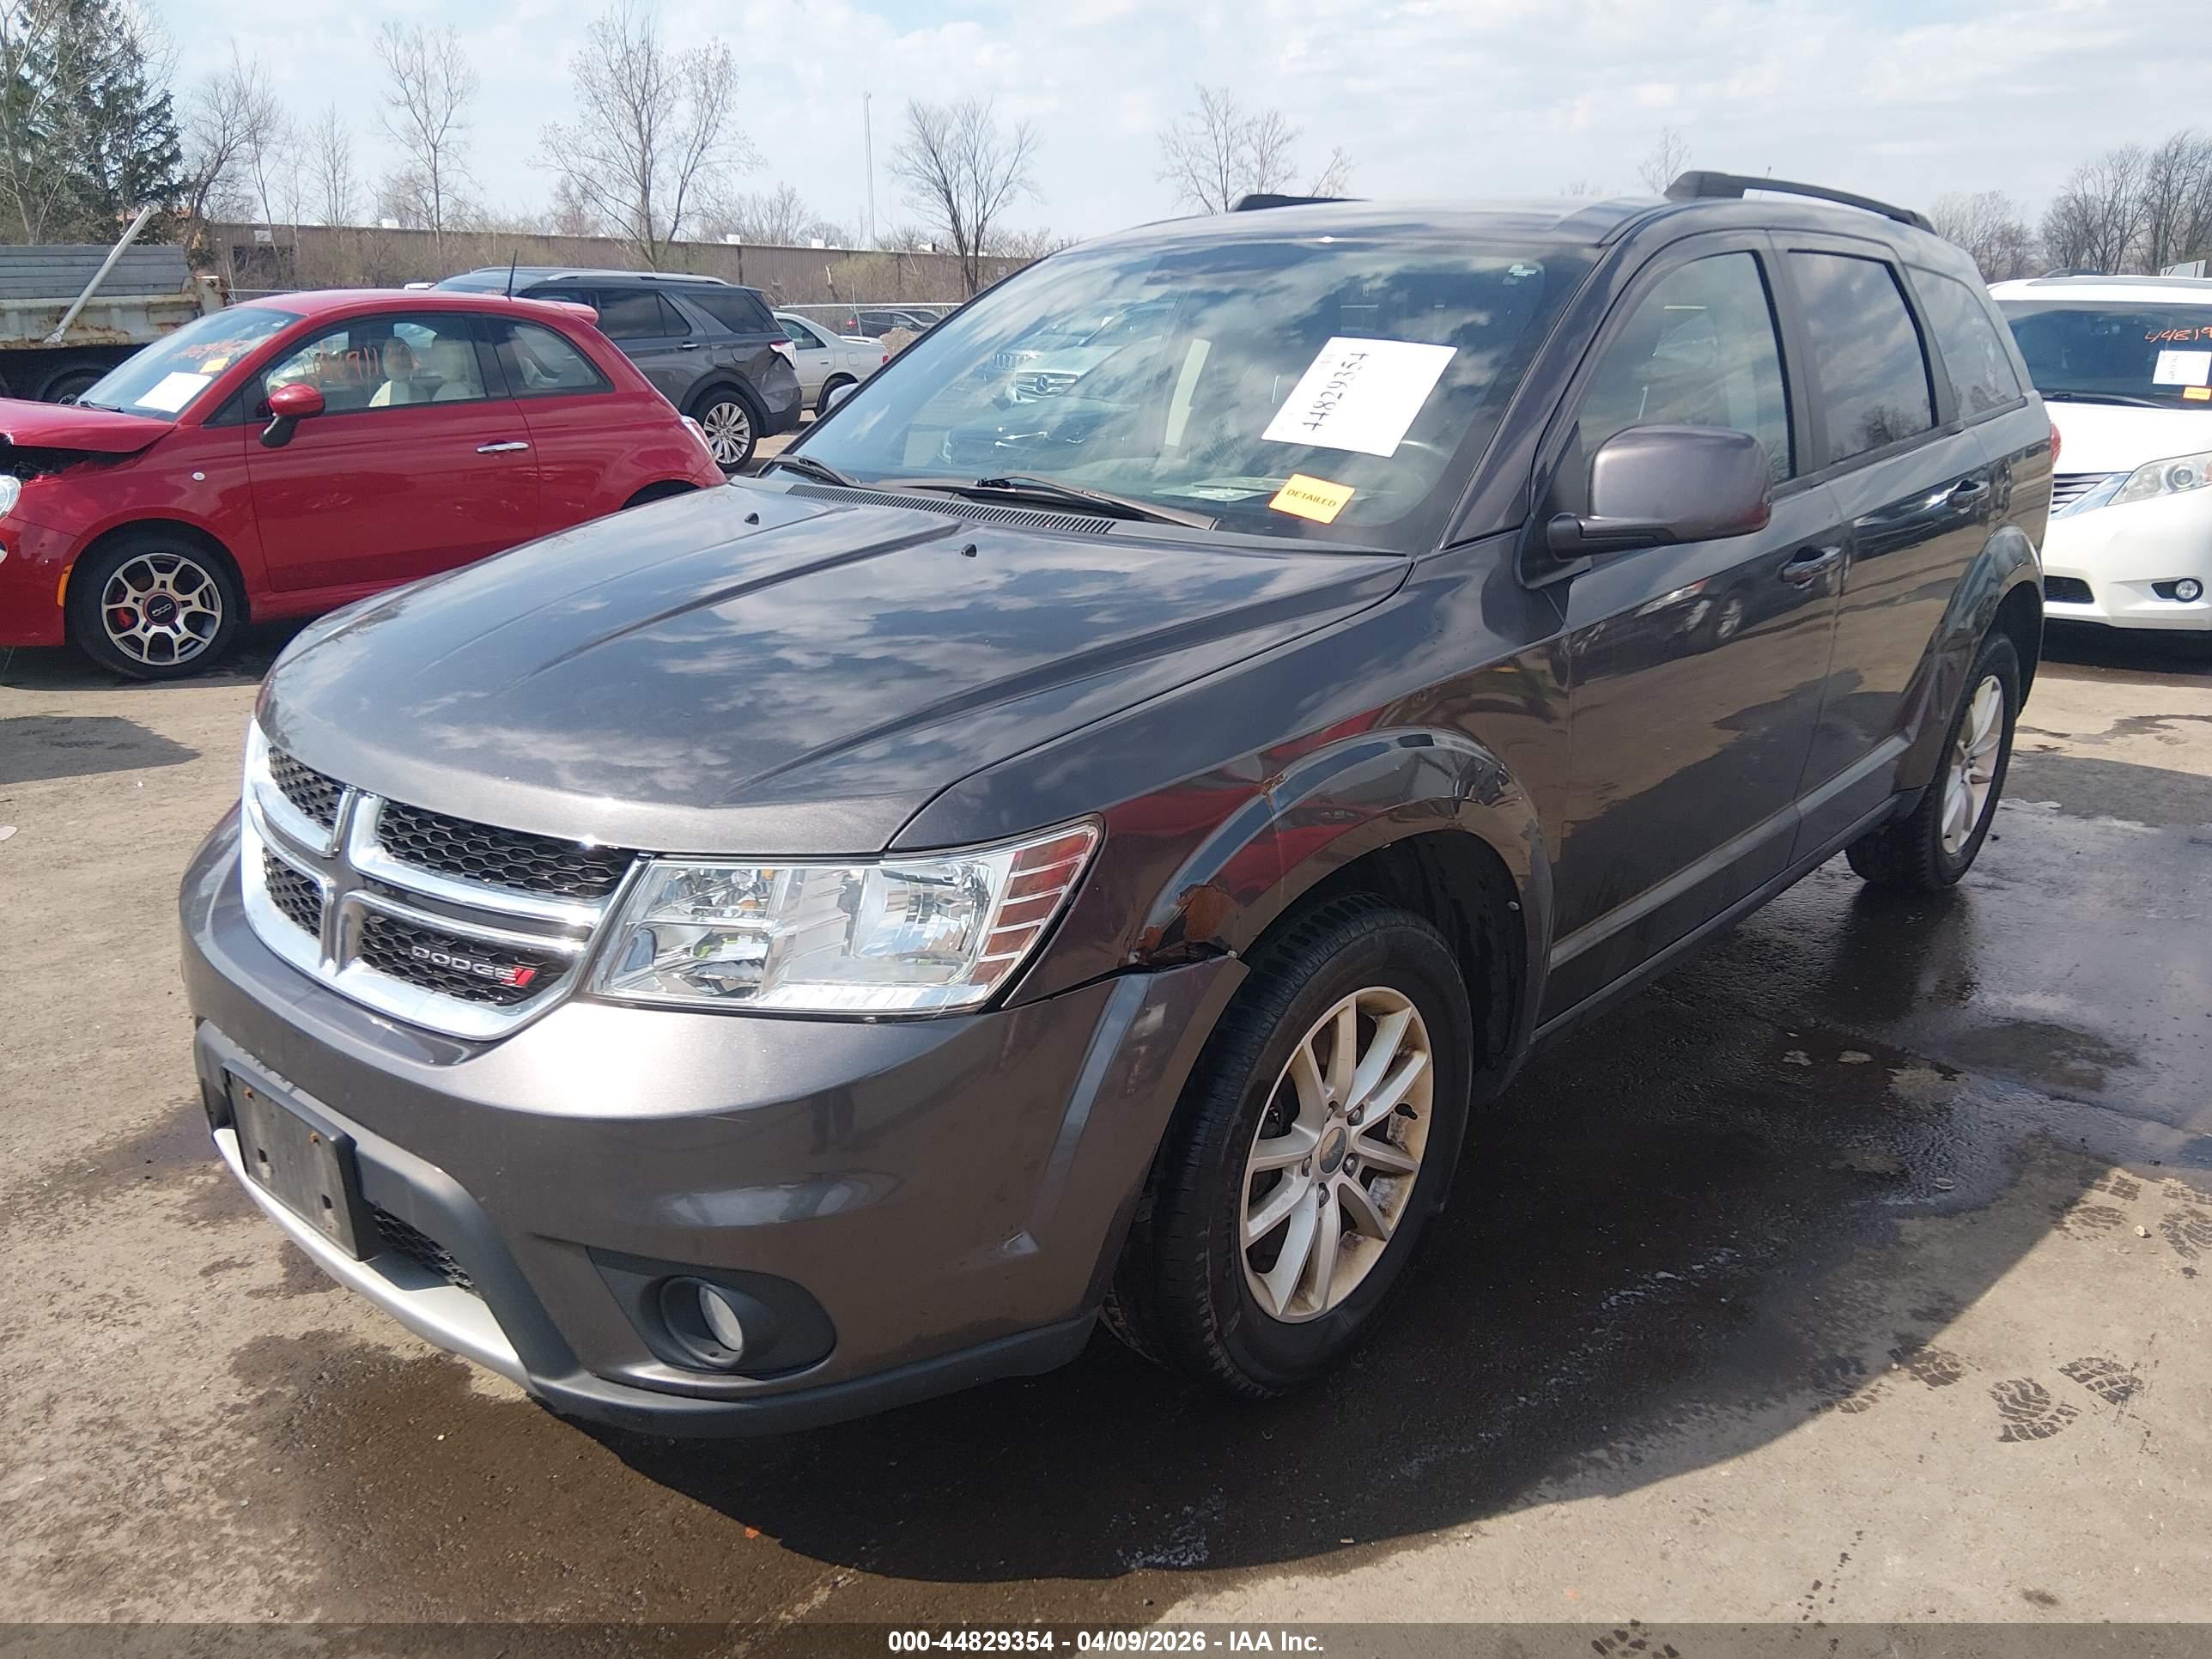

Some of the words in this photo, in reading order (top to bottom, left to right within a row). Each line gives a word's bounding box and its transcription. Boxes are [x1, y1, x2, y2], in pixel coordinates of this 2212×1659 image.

[1302, 352, 1370, 431] 44829354
[1286, 489, 1337, 507] DETAILED
[411, 945, 517, 981] DODGE
